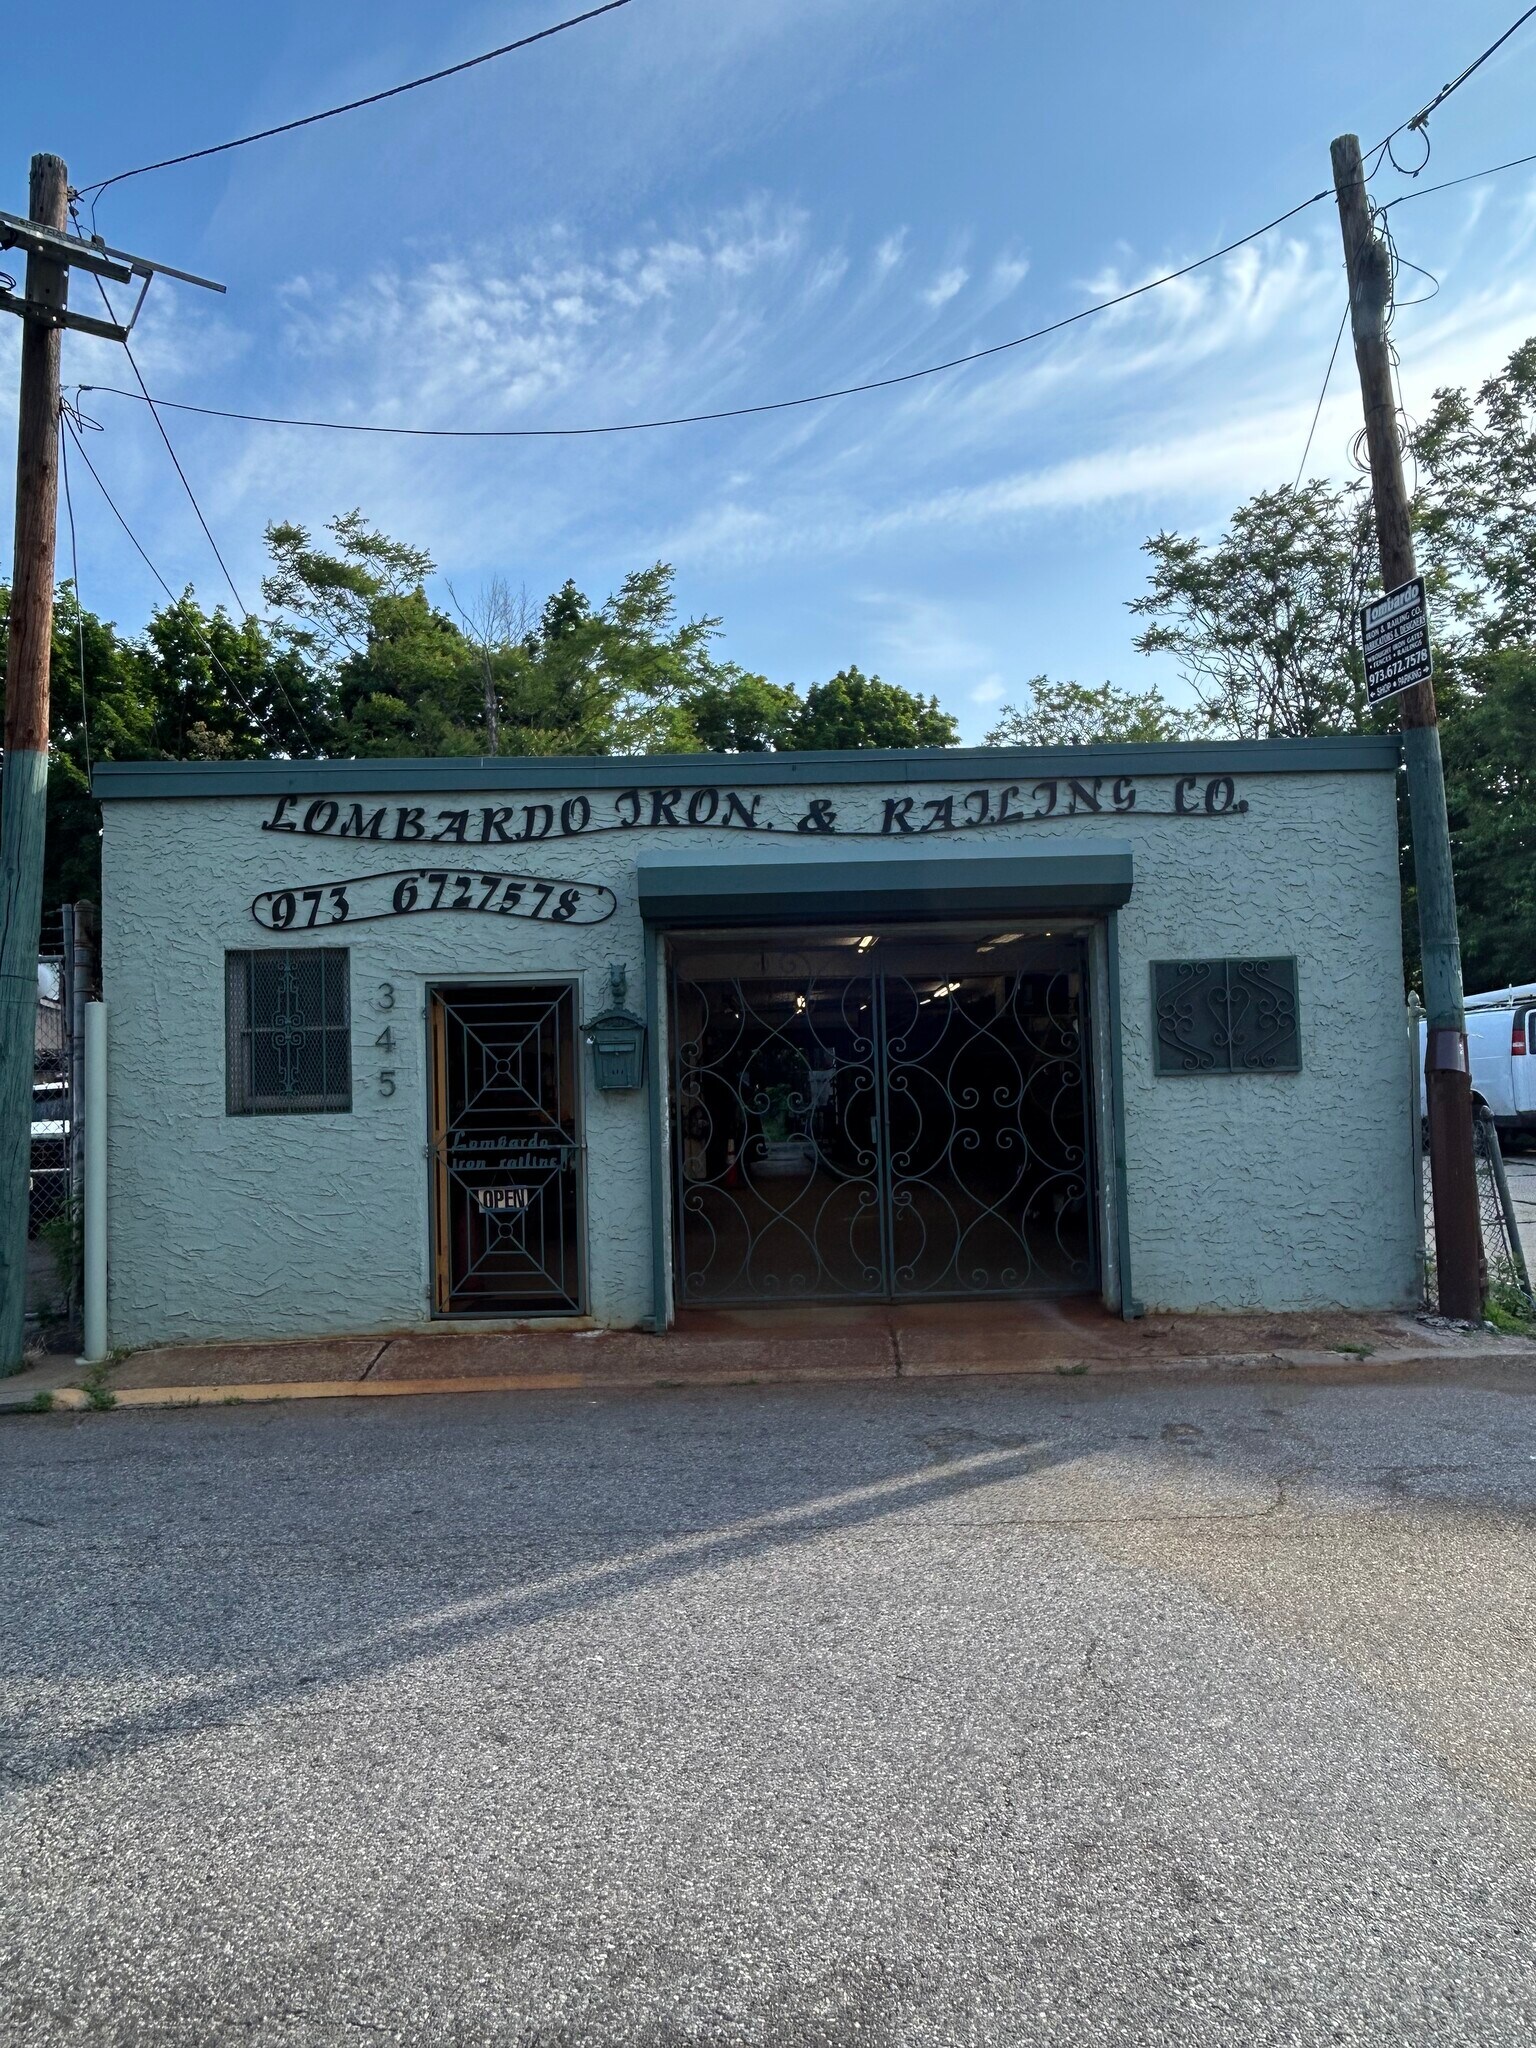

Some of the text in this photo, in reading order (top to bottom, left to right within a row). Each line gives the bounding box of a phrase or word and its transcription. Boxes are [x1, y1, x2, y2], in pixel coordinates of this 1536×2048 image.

[1365, 584, 1420, 631] Lombardo
[1365, 629, 1379, 641] IRON
[1387, 612, 1410, 631] RAILING
[1406, 631, 1424, 644] GATES
[1368, 649, 1428, 686] 973.672.7578
[1376, 668, 1422, 697] SHOP PARKING
[262, 795, 591, 843] LOMBARDO
[798, 798, 838, 833] &
[880, 776, 1137, 834] RAILING
[1175, 776, 1249, 814] CO.
[271, 870, 581, 930] 973 6727578
[450, 1130, 549, 1152] Lombardo
[452, 1157, 486, 1169] iron
[482, 1188, 525, 1208] OPEN
